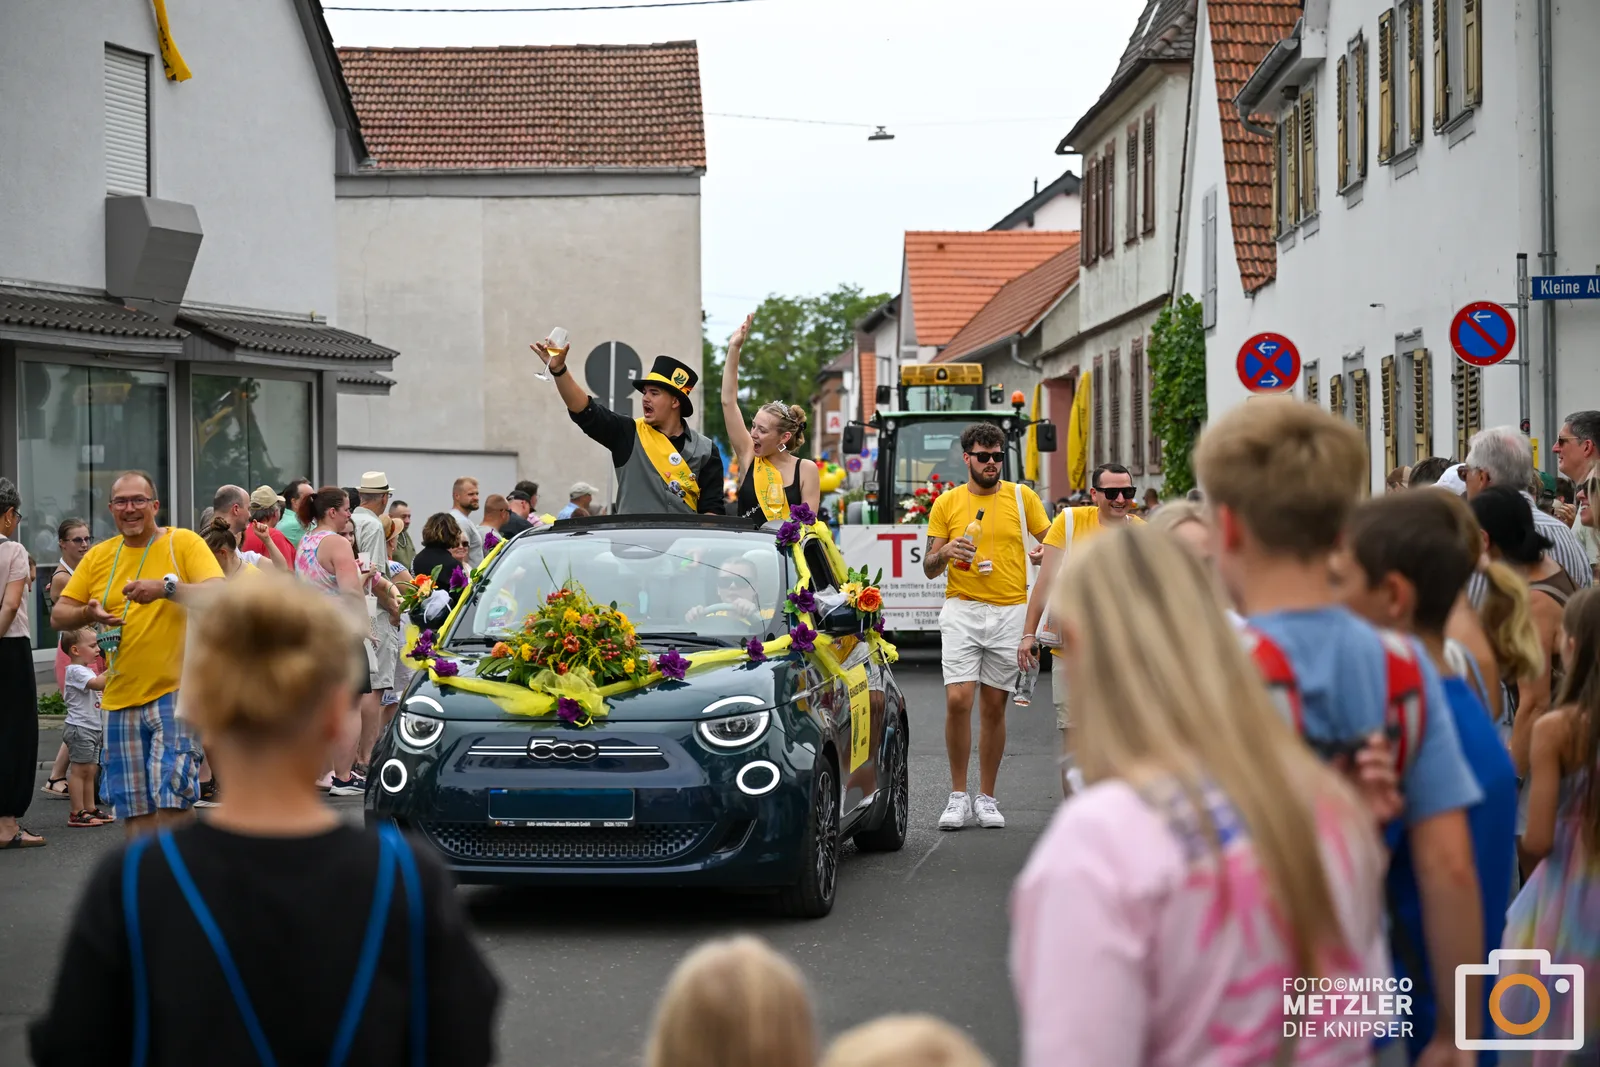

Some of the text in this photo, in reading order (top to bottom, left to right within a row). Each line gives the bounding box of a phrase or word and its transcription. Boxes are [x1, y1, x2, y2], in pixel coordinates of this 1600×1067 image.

[1541, 278, 1600, 294] Kleine Al
[530, 739, 596, 759] 500
